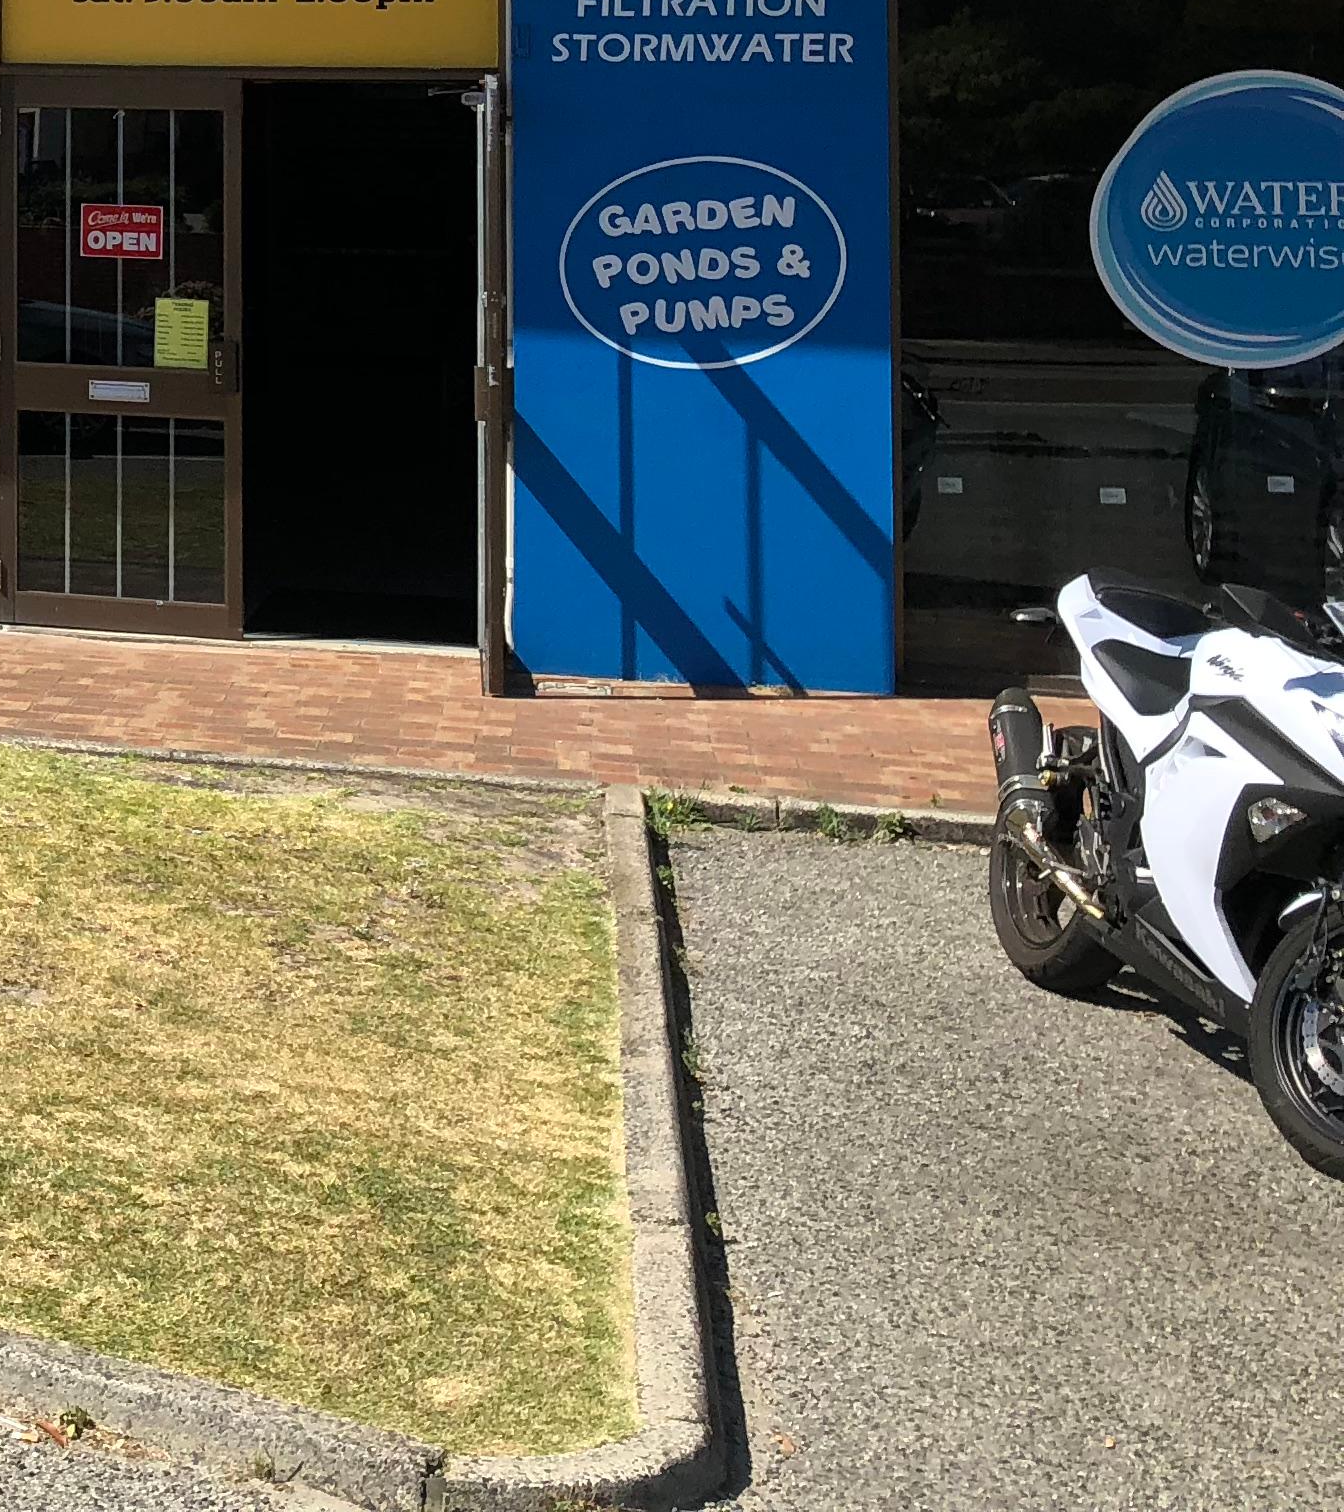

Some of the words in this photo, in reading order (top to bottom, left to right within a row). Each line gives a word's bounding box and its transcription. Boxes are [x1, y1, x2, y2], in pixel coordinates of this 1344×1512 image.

[551, 33, 854, 63] STORMWATER
[598, 194, 796, 237] GARDEN
[87, 230, 157, 252] OPEN
[1147, 238, 1344, 269] waterwis
[592, 246, 761, 289] PONDS
[777, 244, 811, 278] &
[619, 294, 795, 335] PUMPS
[214, 350, 223, 385] PULL
